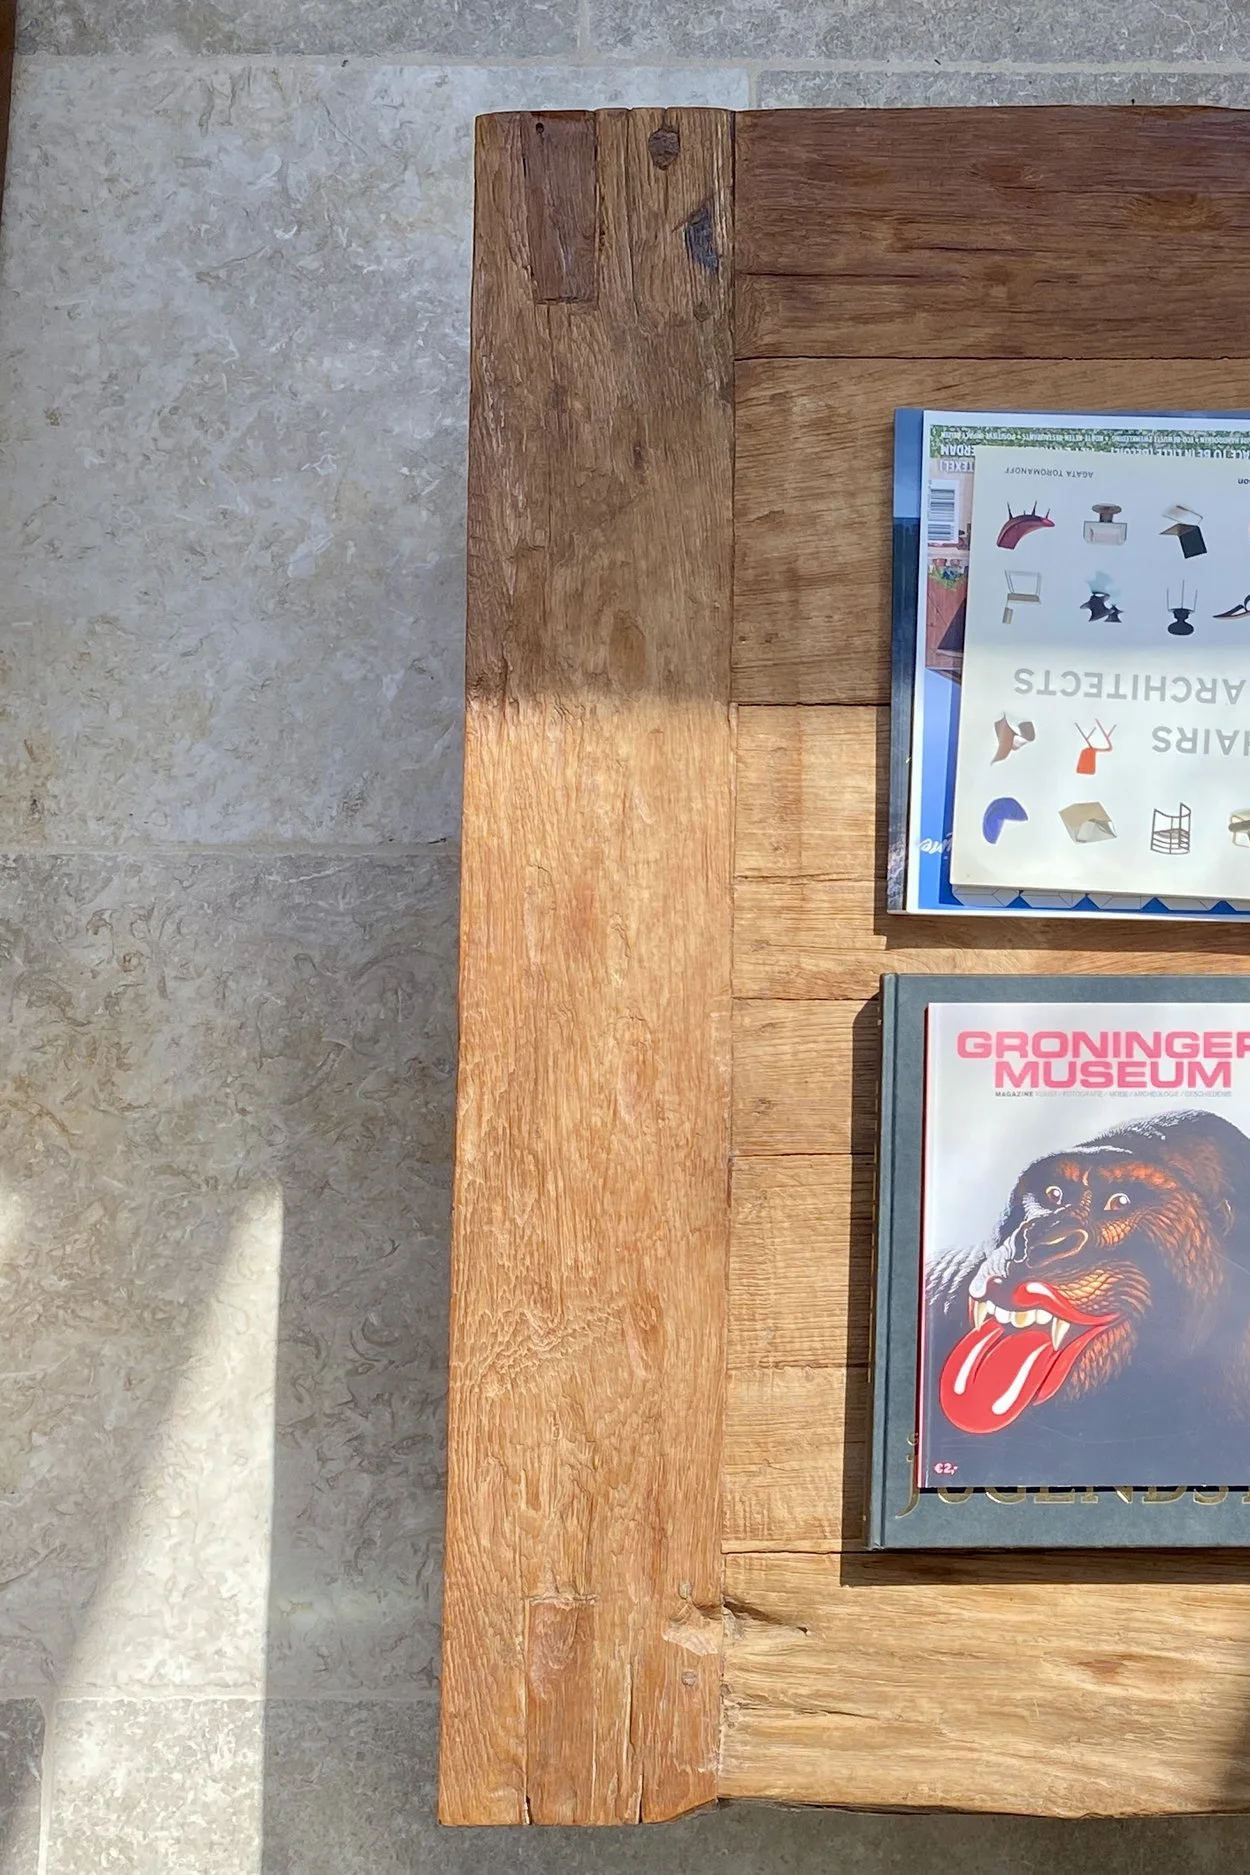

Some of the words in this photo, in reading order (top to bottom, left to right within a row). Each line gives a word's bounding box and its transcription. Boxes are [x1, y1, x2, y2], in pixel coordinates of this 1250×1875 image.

[1004, 467, 1063, 477] TOROMANOFF
[1066, 470, 1094, 478] AGATA
[1014, 668, 1245, 705] ARCHITECTS
[994, 1061, 1232, 1088] MUSEUM
